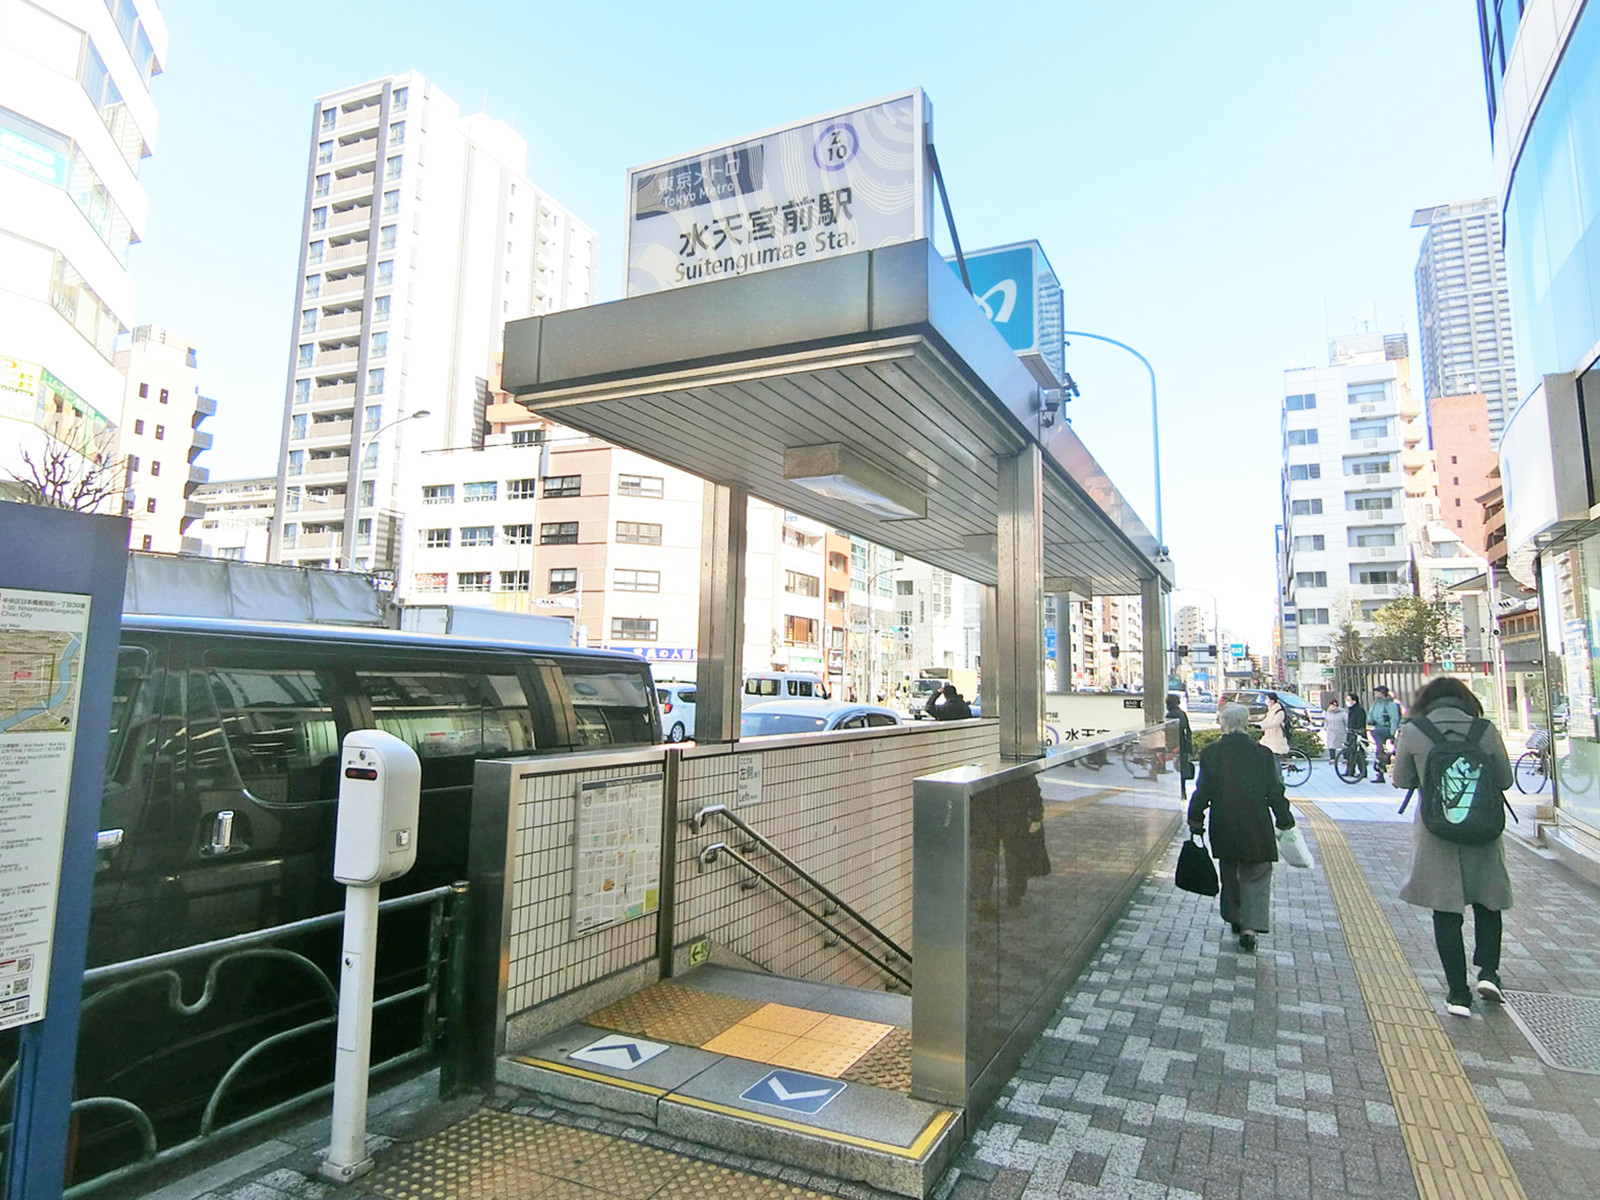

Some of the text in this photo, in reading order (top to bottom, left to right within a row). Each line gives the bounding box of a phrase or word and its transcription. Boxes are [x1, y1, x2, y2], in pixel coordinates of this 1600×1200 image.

[830, 130, 842, 146] Z
[826, 143, 848, 163] 10
[658, 157, 740, 195] 東京メトロ
[662, 182, 734, 208] Tokyo Metro
[678, 186, 853, 258] 水天宮前駅
[674, 228, 856, 283] Suitengumae Sta.
[1065, 728, 1111, 742] 水天
